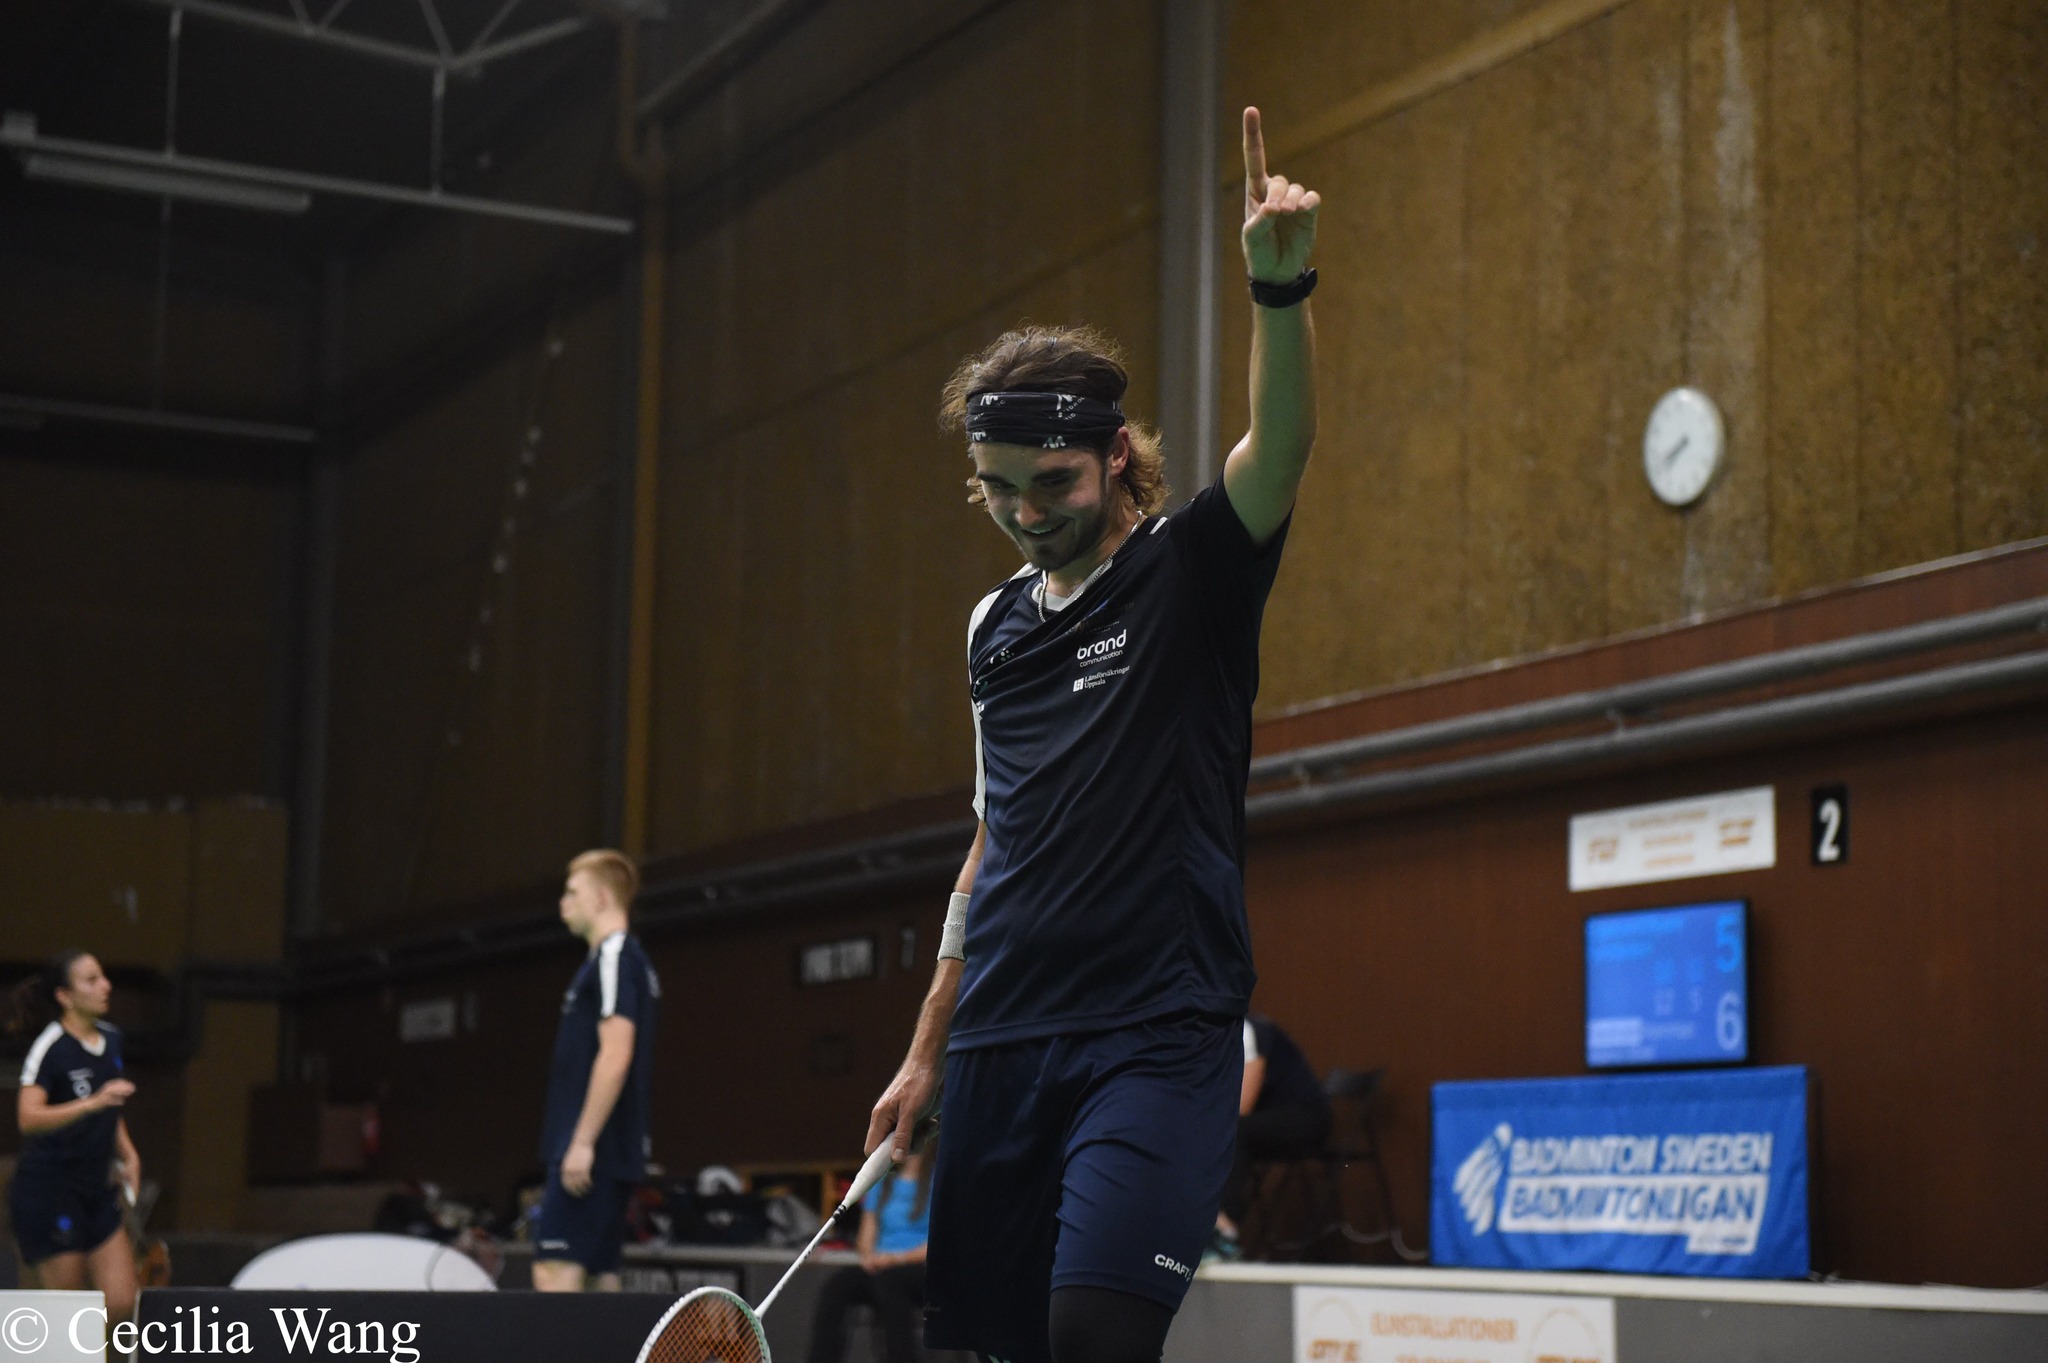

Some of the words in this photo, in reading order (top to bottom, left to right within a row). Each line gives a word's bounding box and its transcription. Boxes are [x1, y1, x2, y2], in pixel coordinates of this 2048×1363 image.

[1076, 628, 1127, 660] brand
[1079, 649, 1123, 668] communication
[1084, 678, 1106, 689] Uppsala
[1817, 799, 1842, 863] 2
[1716, 912, 1742, 973] 5
[1716, 990, 1743, 1051] 6
[1510, 1135, 1658, 1174] BADMINTON
[1660, 1132, 1773, 1172] SWEDEN
[1510, 1183, 1760, 1220] BADMINTONLIGAN
